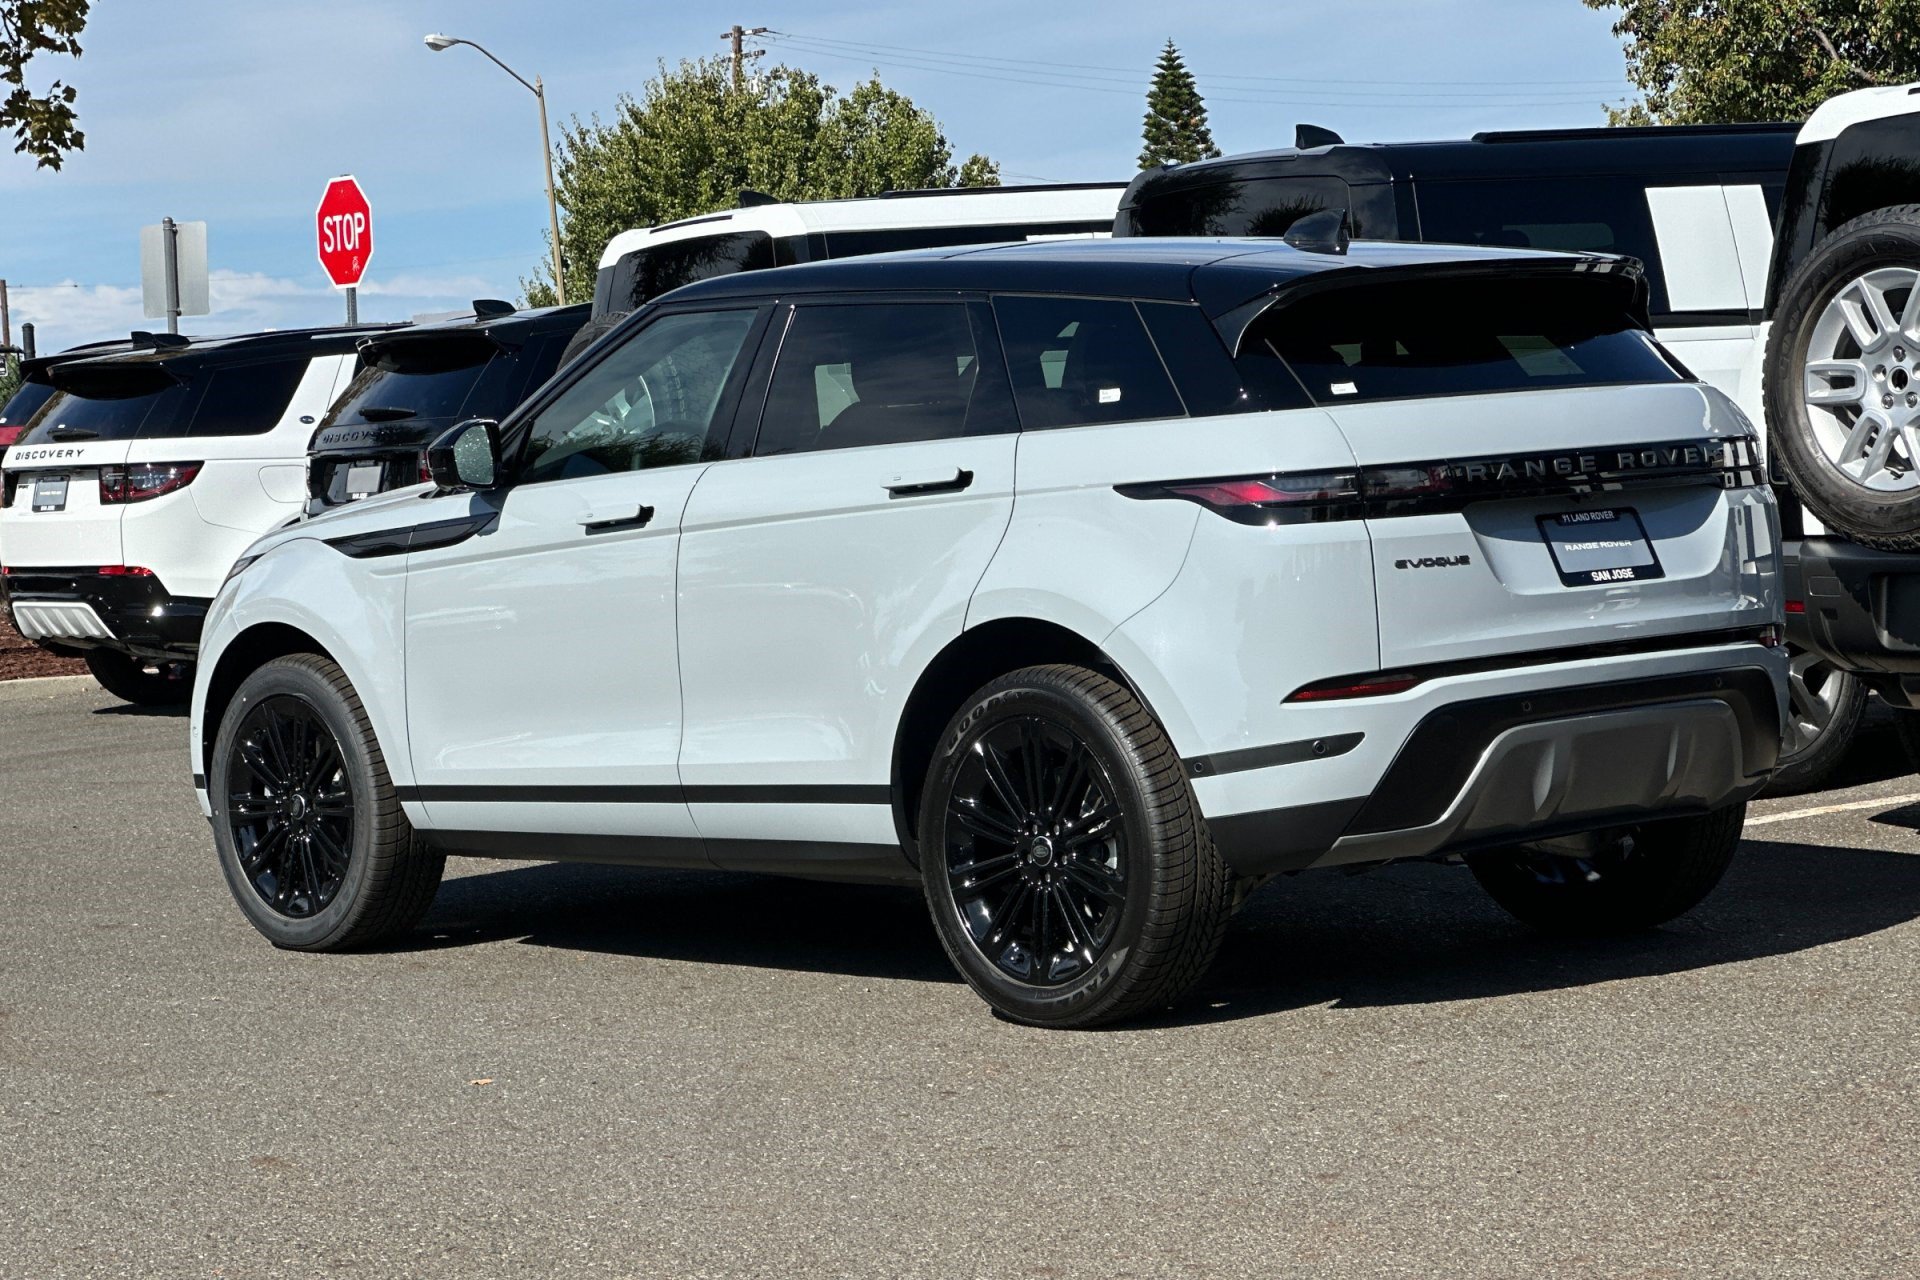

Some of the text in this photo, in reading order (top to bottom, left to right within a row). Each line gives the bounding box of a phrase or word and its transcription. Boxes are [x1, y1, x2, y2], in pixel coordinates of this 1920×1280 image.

[323, 211, 365, 253] STOP
[15, 449, 85, 460] DISCOVERY
[1465, 456, 1597, 482] RANGE
[1571, 512, 1591, 522] LAND
[1590, 510, 1615, 521] ROVER
[1564, 540, 1632, 551] RANGE ROVER
[1394, 555, 1471, 569] EVOQUE
[1591, 568, 1635, 581] SAN JOSE
